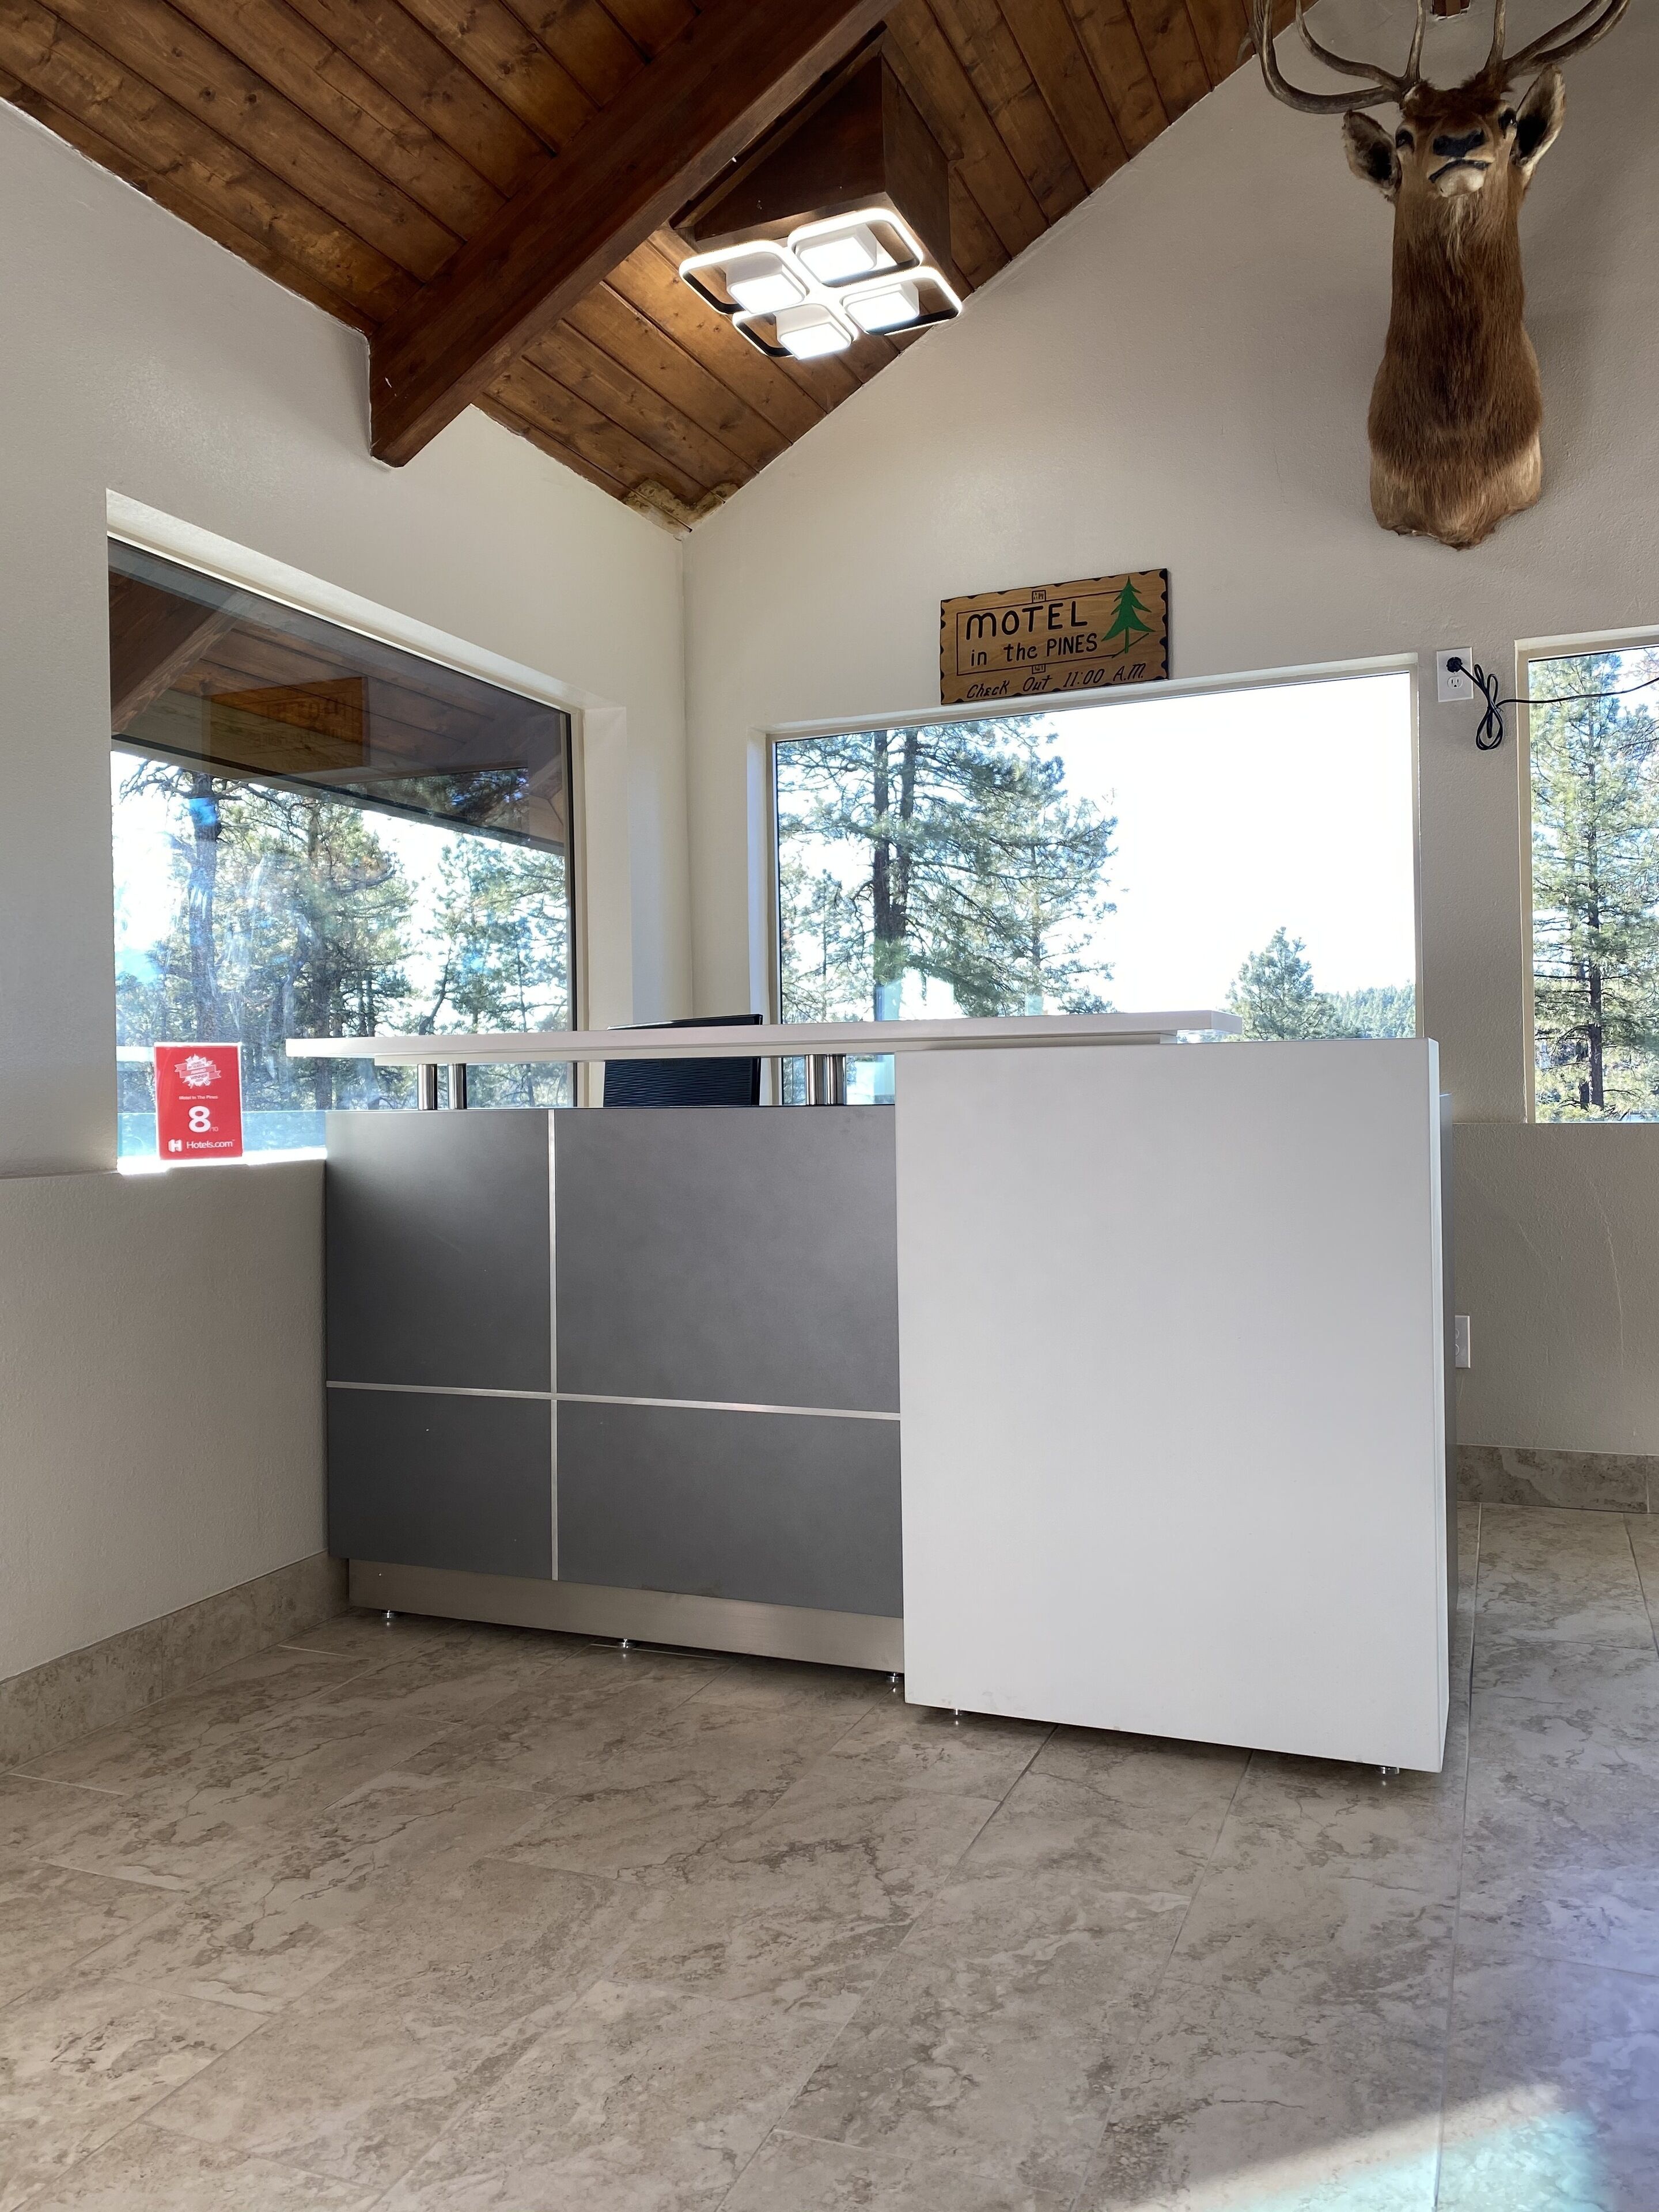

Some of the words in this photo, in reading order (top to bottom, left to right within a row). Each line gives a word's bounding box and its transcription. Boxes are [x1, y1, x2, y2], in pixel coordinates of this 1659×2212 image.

[966, 601, 1088, 640] MOTEL
[971, 649, 987, 666] in
[1003, 642, 1037, 662] the
[1046, 633, 1097, 657] PINES
[967, 680, 1010, 699] Check
[1022, 675, 1053, 692] Out
[1063, 668, 1105, 687] 11:00
[1113, 663, 1146, 681] A.M.
[188, 1105, 211, 1133] 8
[186, 1141, 233, 1149] Hotels.com
